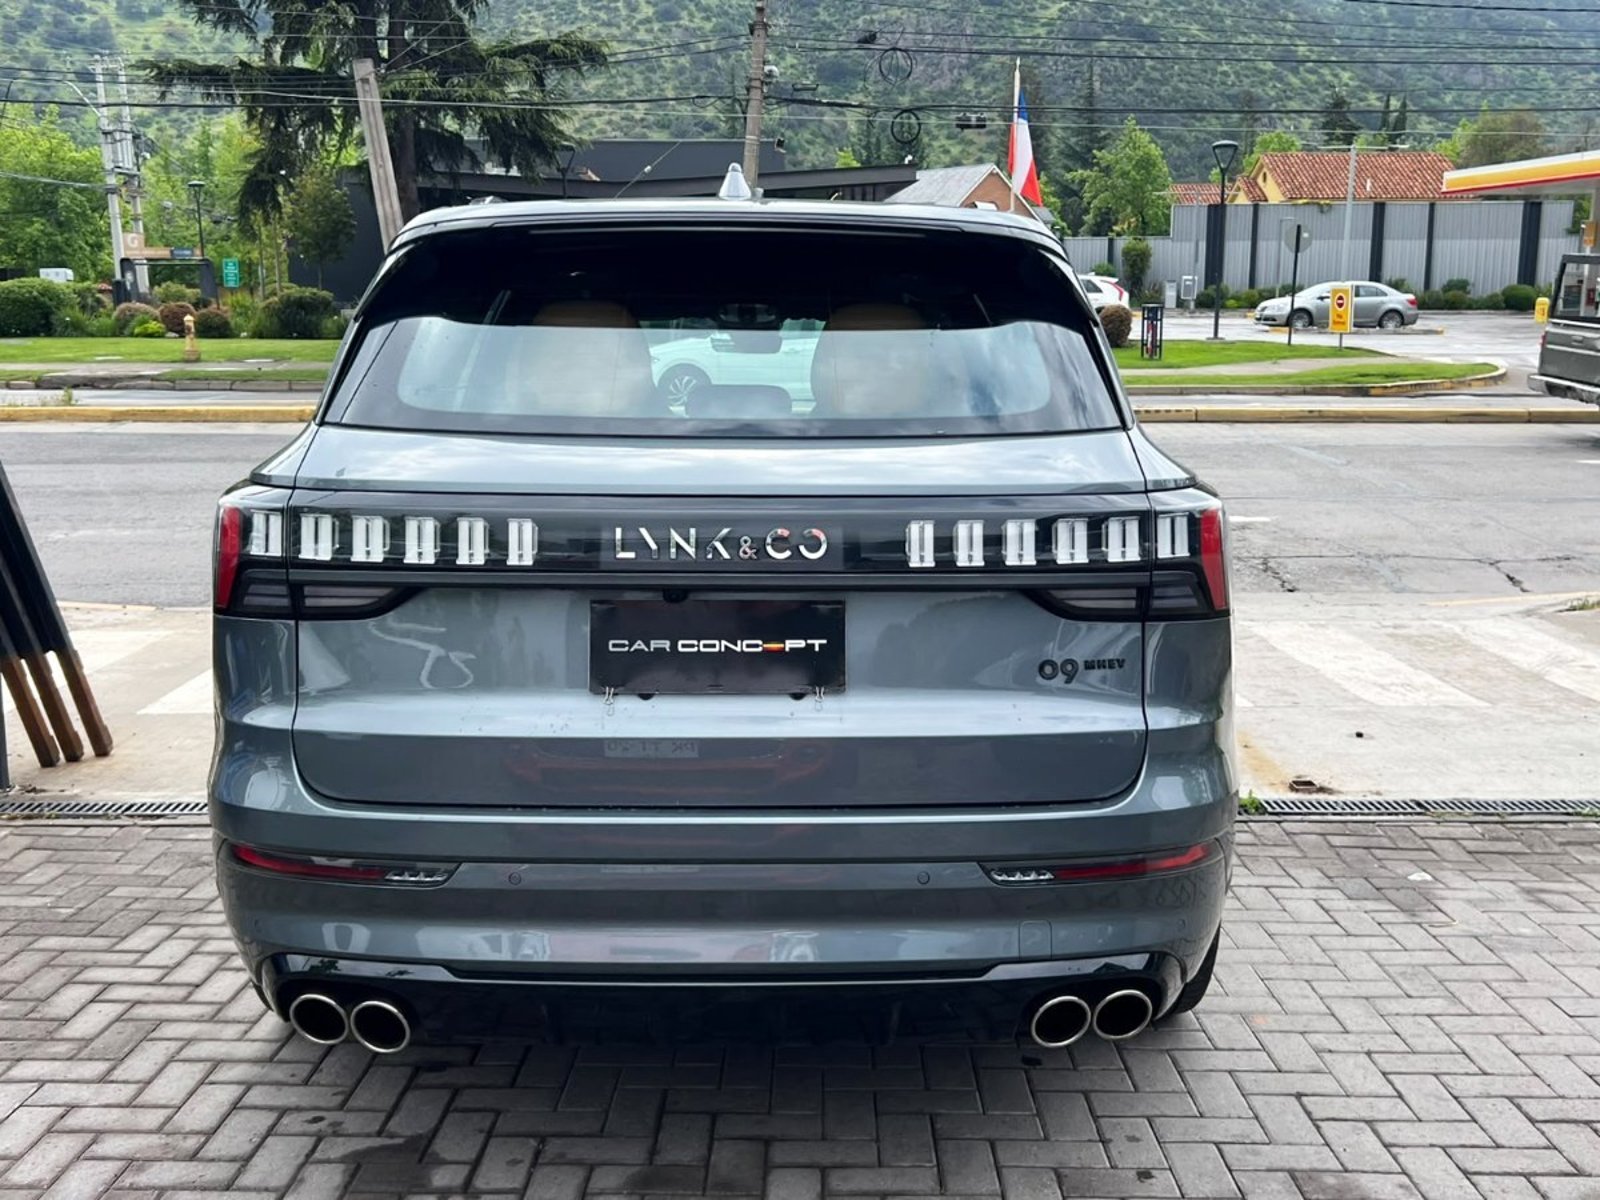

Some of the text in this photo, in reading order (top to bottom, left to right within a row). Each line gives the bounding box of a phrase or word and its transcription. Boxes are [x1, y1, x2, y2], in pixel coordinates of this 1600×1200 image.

[608, 639, 671, 652] CAR
[1038, 658, 1125, 684] 09 MHEV
